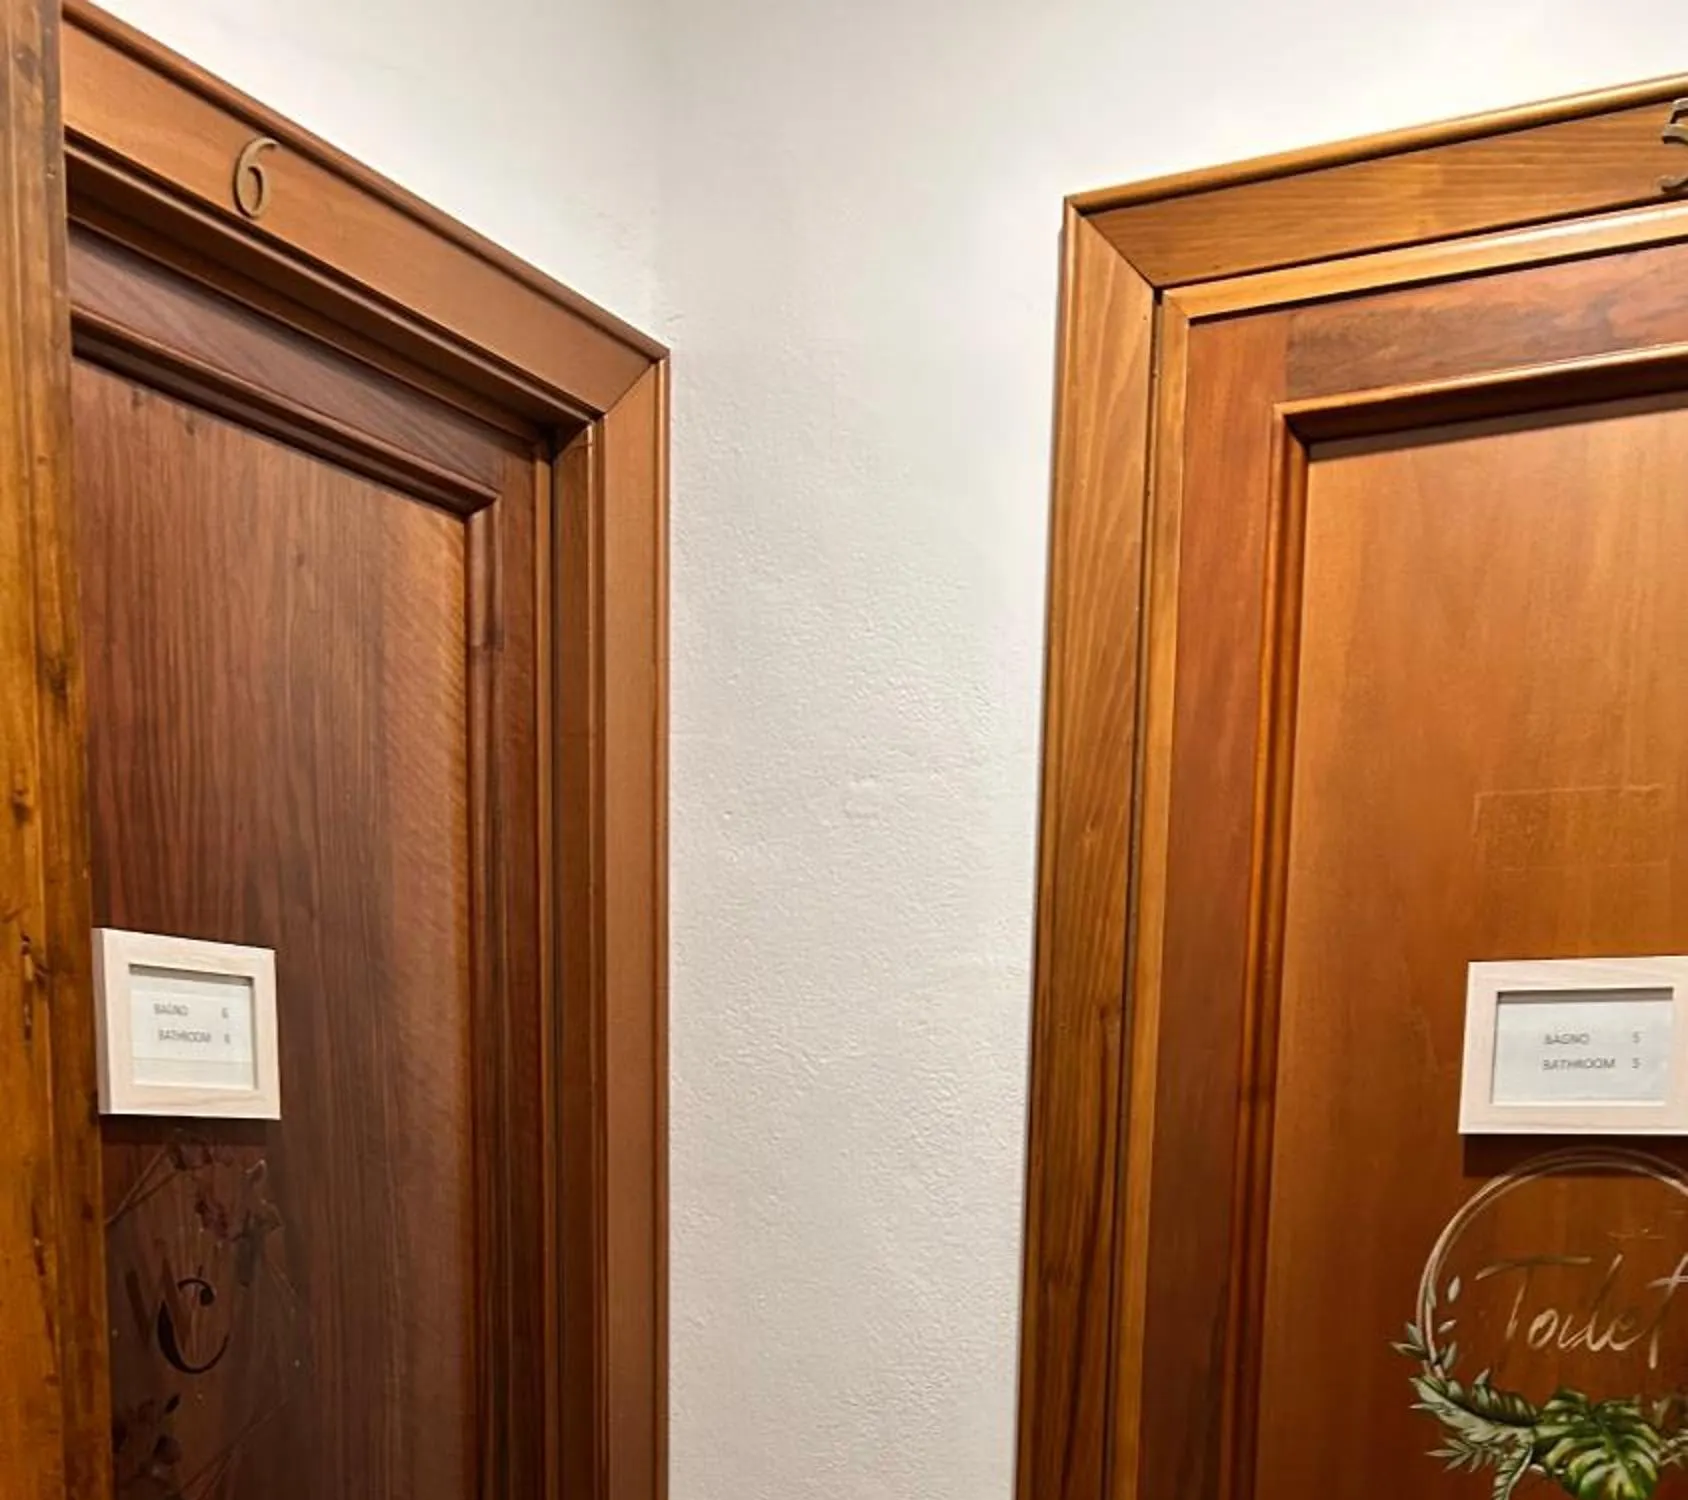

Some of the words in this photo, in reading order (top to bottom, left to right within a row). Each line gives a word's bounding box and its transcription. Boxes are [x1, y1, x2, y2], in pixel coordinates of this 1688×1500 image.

[233, 137, 278, 219] 6
[153, 1002, 189, 1017] BAGNO
[159, 1028, 212, 1043] BATHROOM
[1543, 1032, 1590, 1046] BAGNO
[1631, 1031, 1643, 1044] 5
[1542, 1057, 1616, 1071] BATHROOM
[1630, 1057, 1641, 1069] 5
[1475, 1252, 1688, 1370] Toilet
